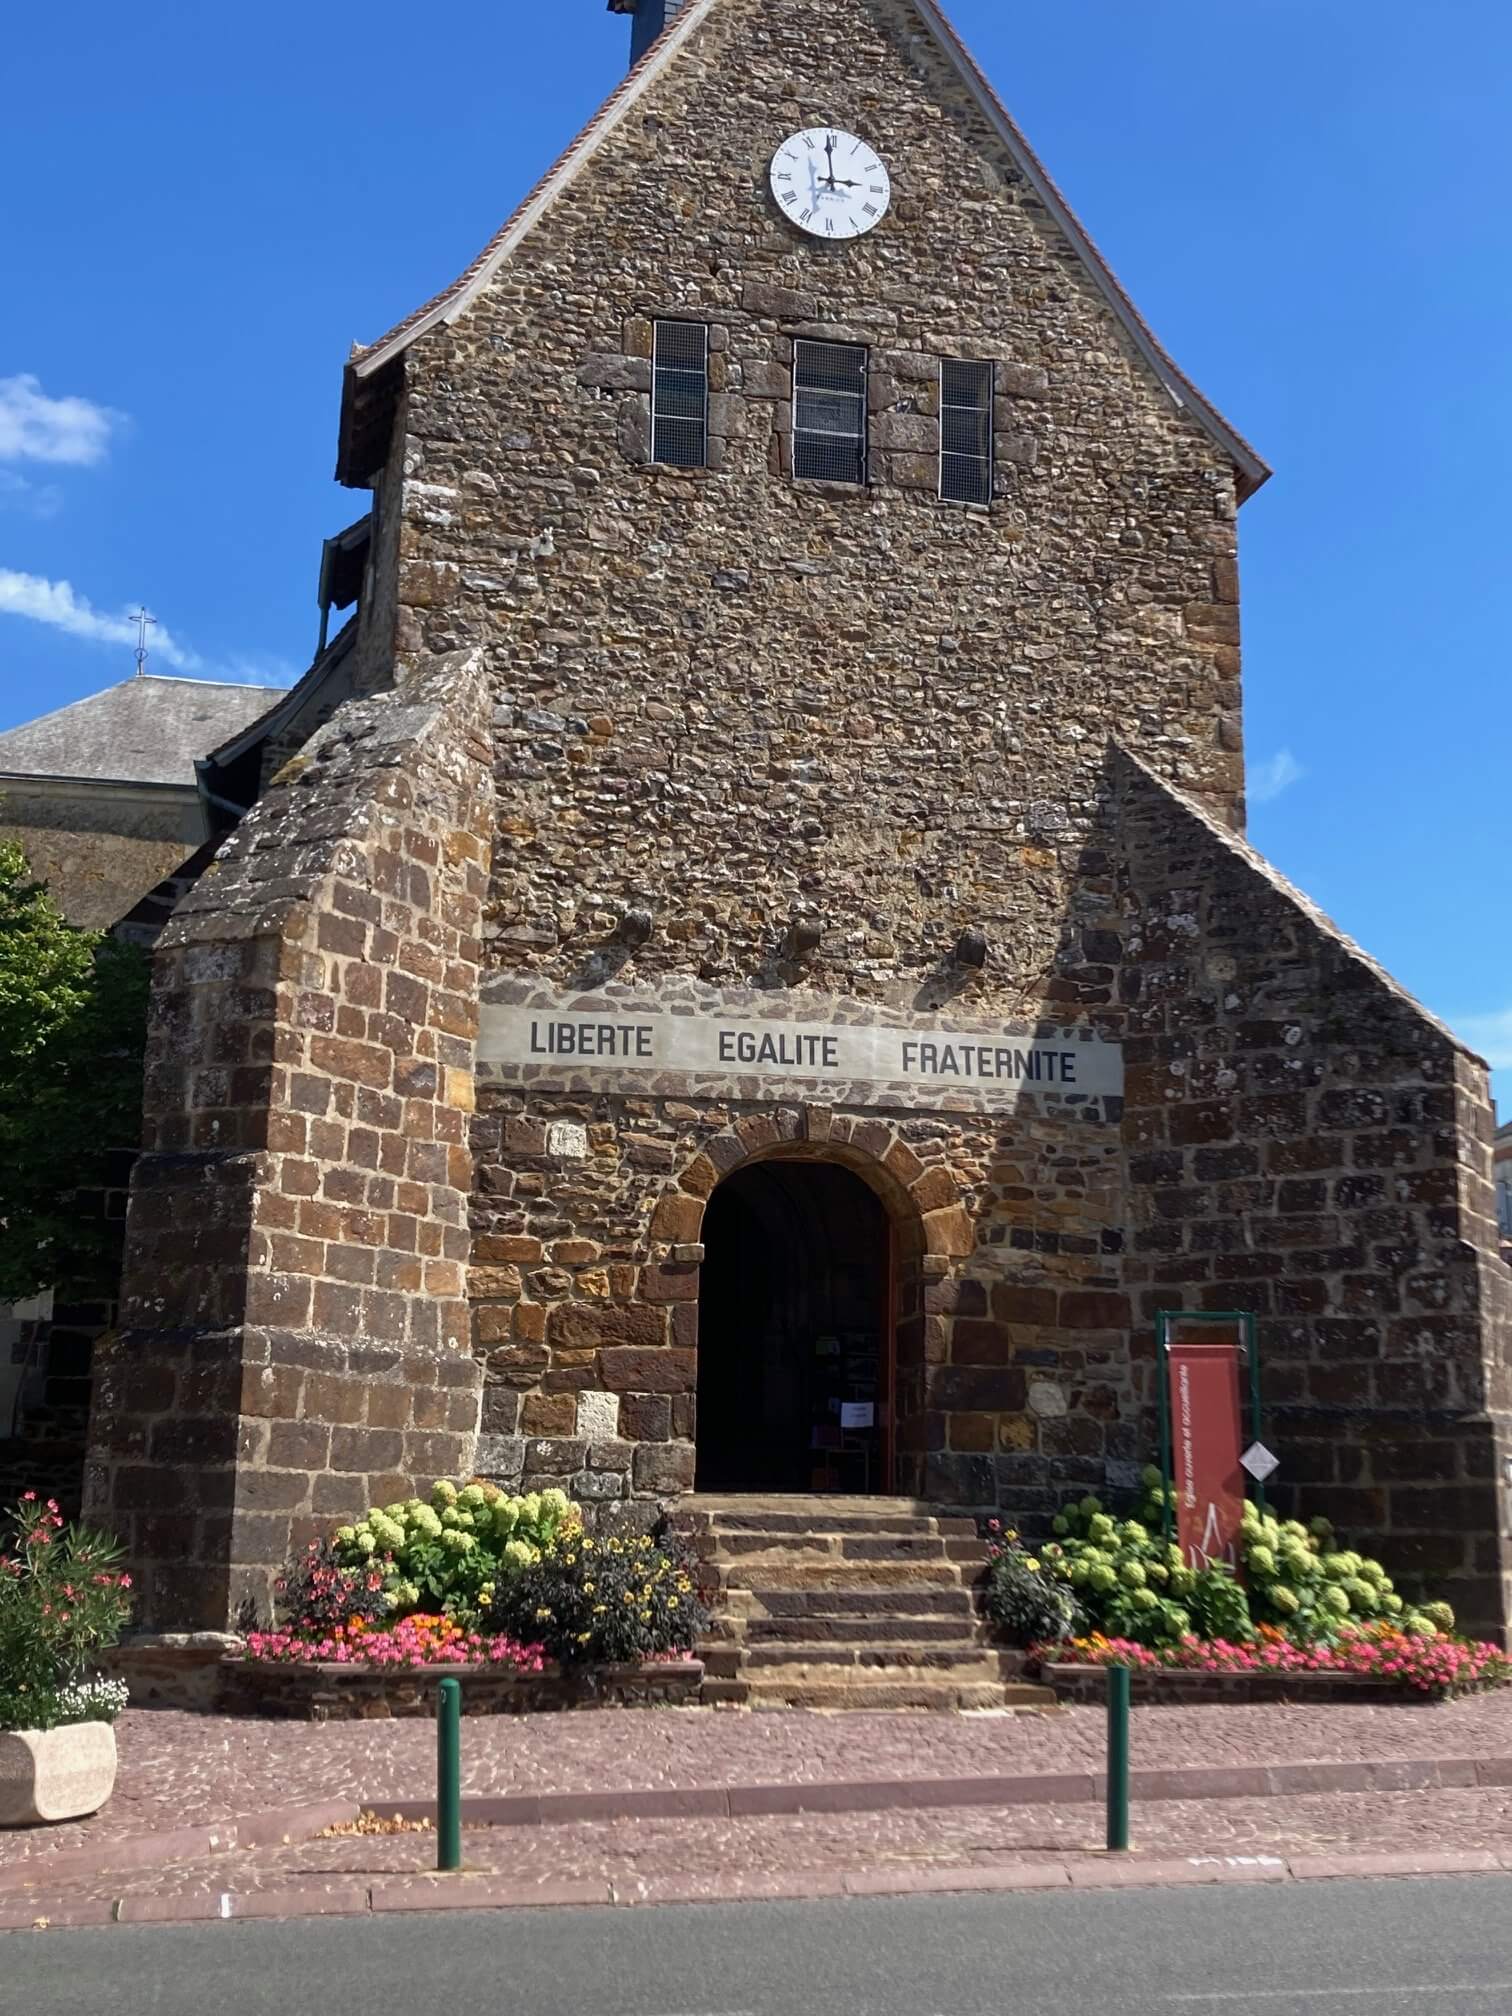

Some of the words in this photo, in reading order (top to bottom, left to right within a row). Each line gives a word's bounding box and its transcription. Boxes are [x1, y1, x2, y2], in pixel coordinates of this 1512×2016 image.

[530, 1021, 653, 1057] LIBERTE
[718, 1031, 838, 1067] EGALITE
[902, 1042, 1077, 1083] FRATERNITE
